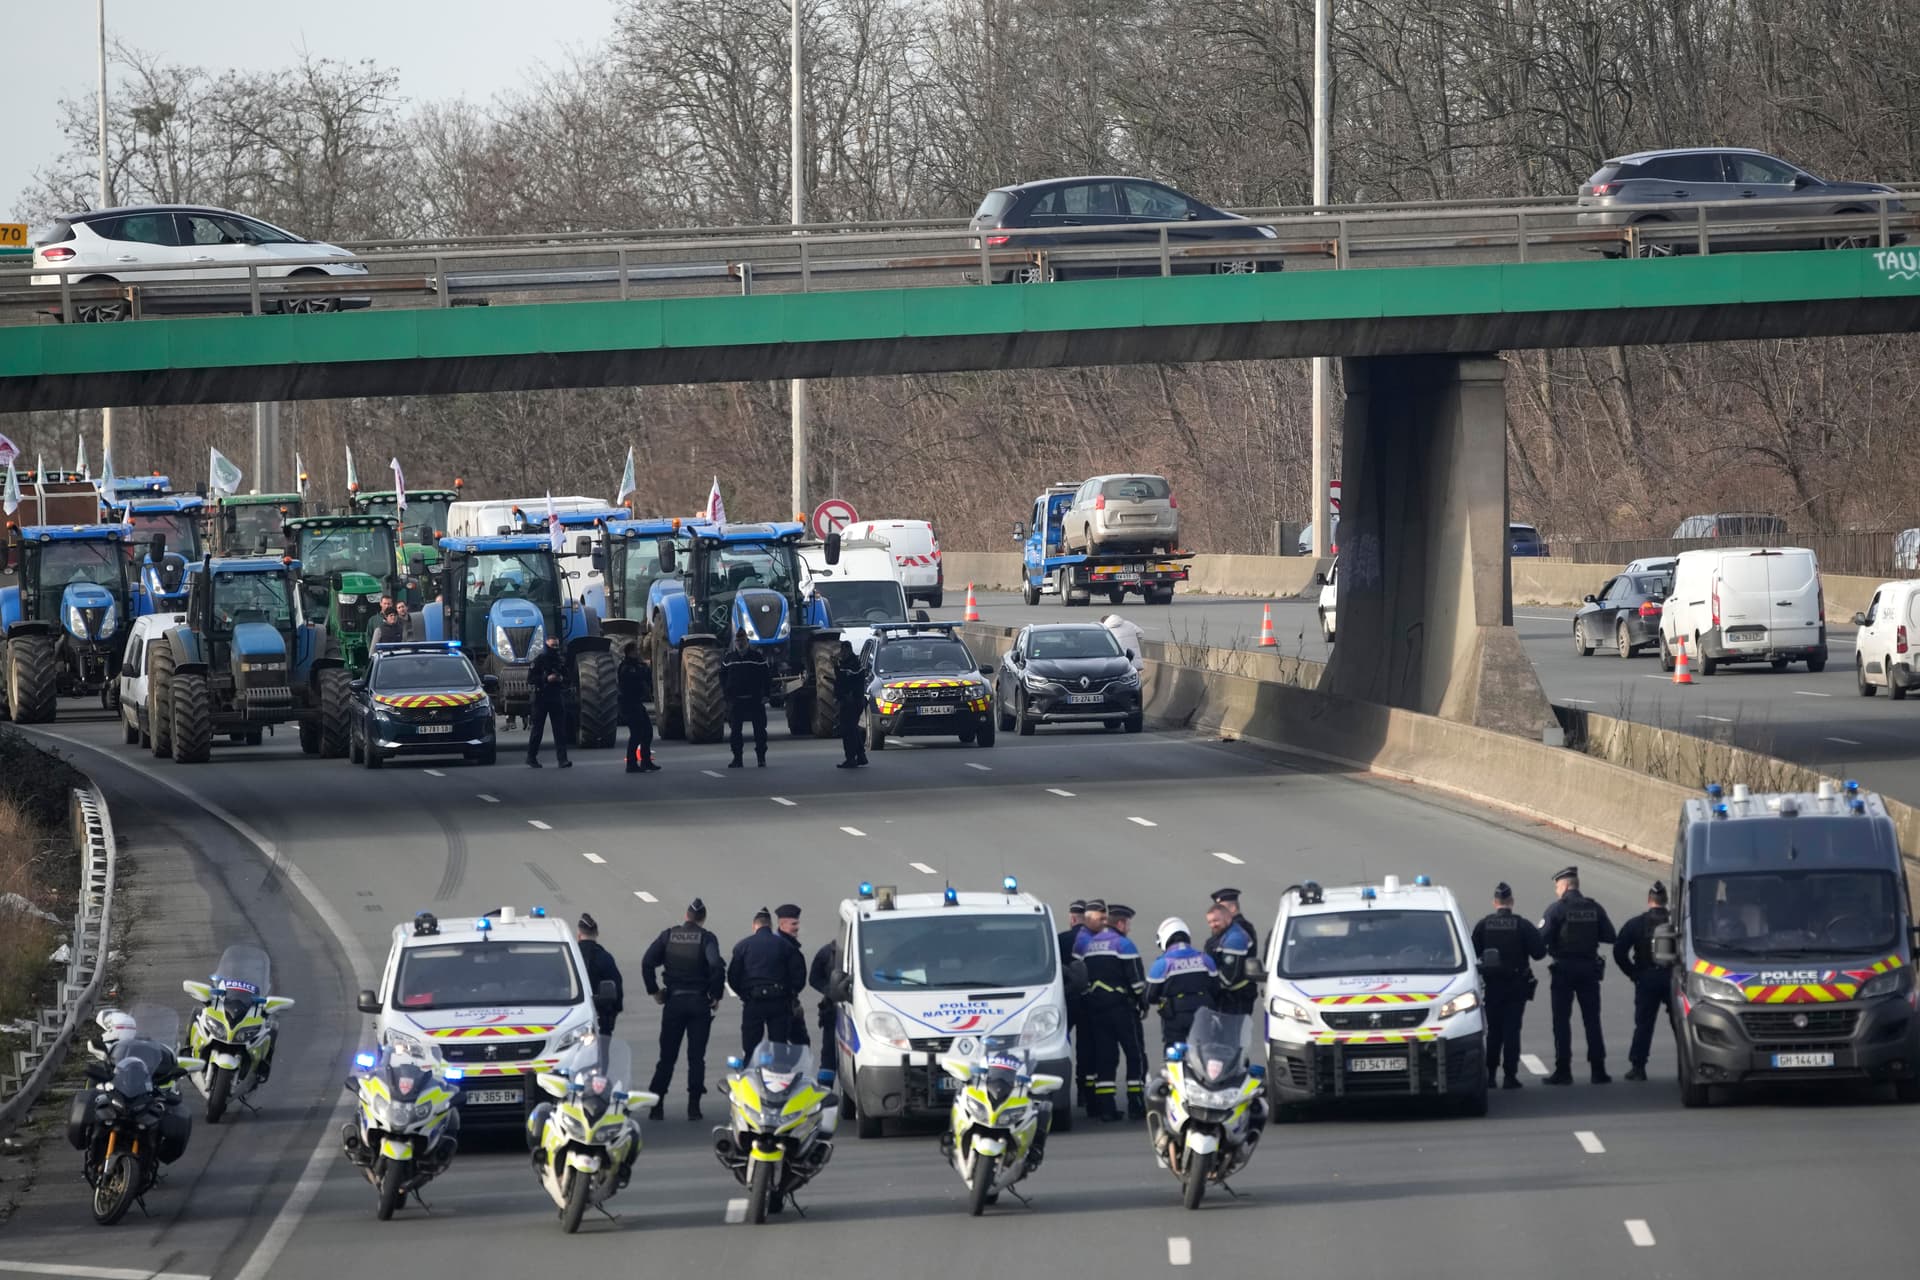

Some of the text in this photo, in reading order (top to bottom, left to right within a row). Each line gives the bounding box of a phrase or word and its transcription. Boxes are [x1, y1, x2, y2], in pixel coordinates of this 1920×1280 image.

[1873, 251, 1920, 271] TAU
[1174, 957, 1204, 970] POLICE
[1761, 970, 1818, 980] POLICE
[226, 981, 256, 991] POLICE
[923, 1008, 1005, 1018] NATIONALE
[988, 1057, 1020, 1067] POLICE
